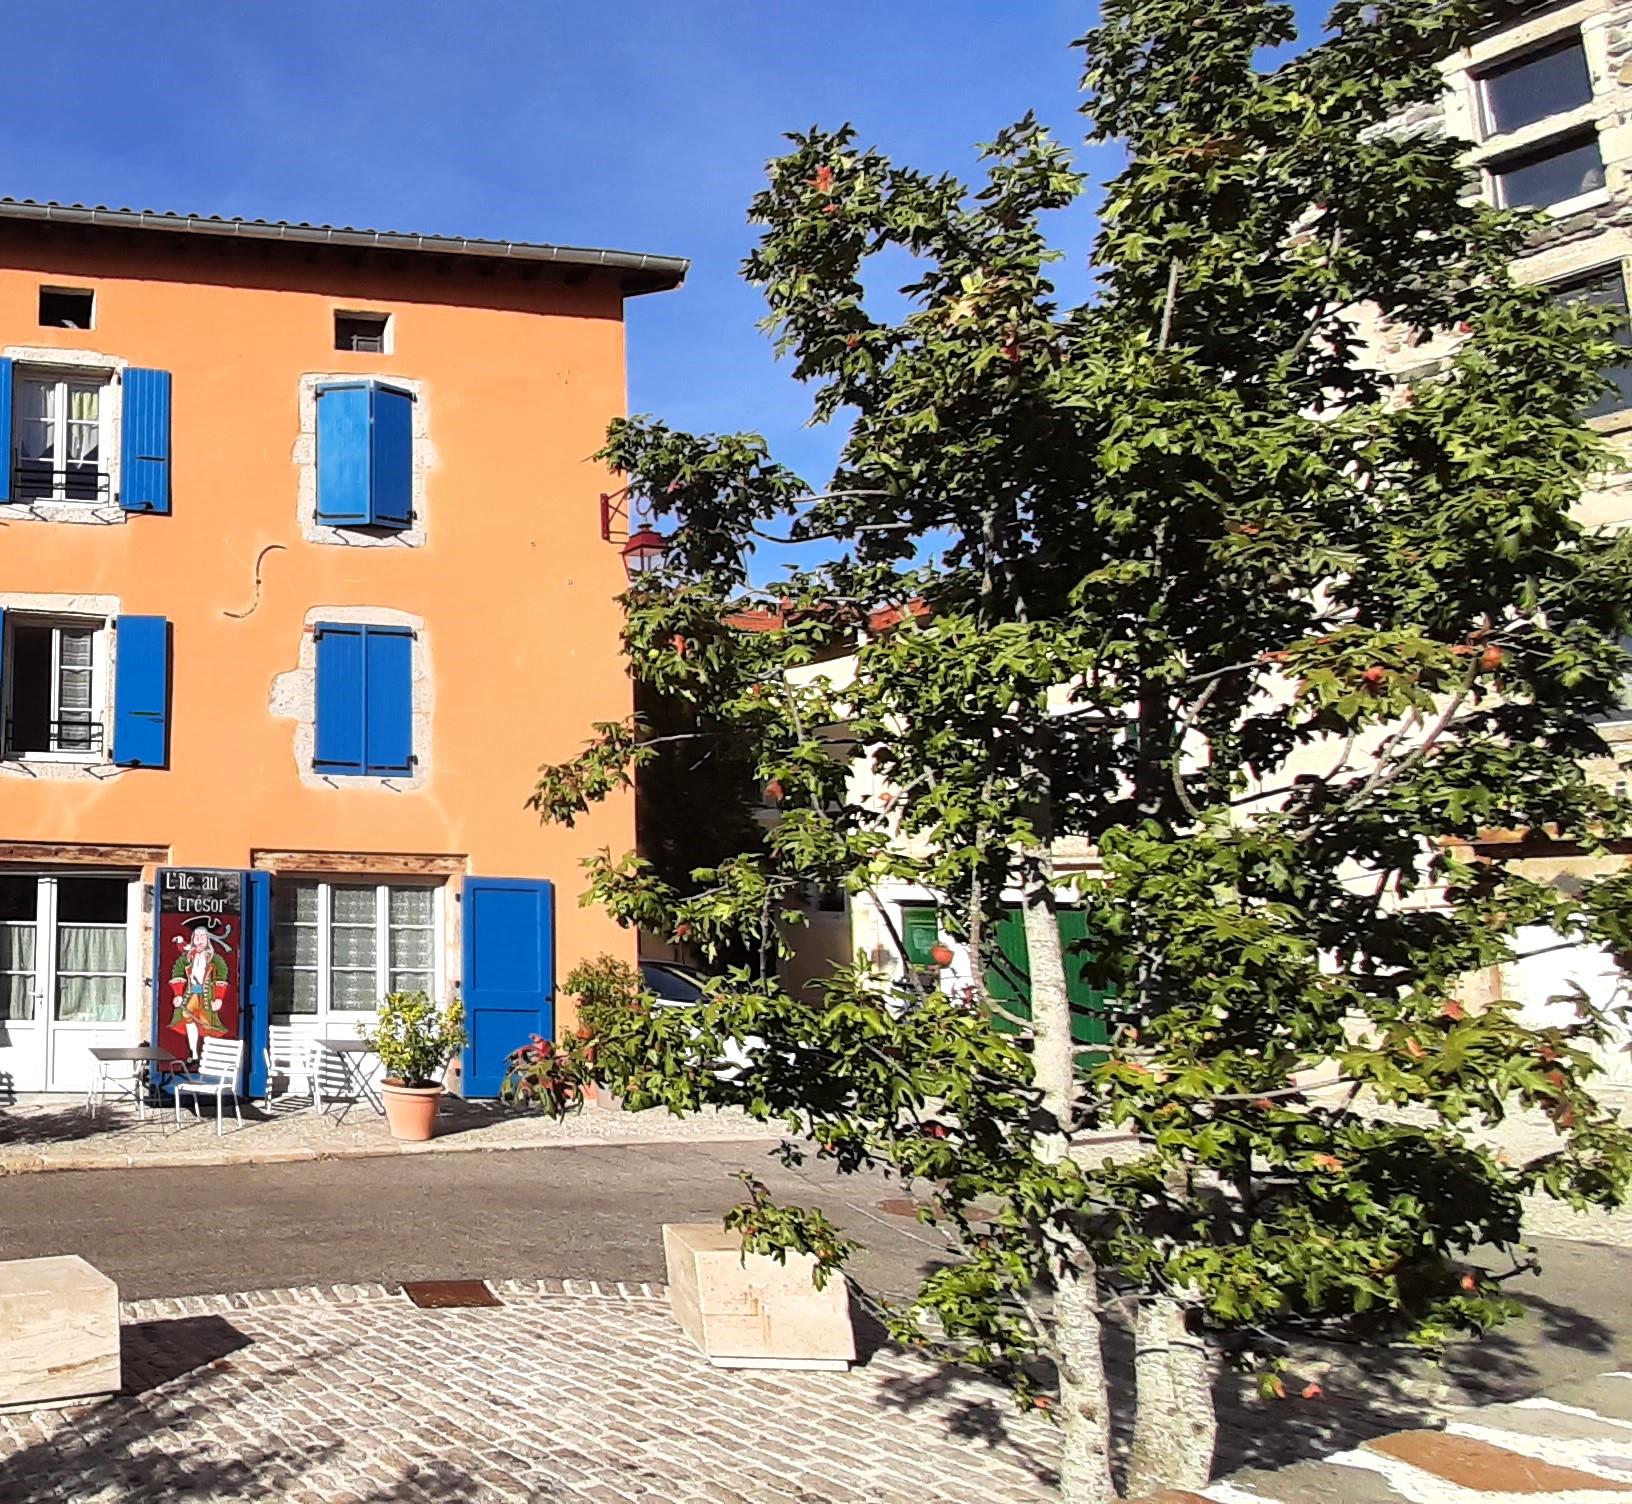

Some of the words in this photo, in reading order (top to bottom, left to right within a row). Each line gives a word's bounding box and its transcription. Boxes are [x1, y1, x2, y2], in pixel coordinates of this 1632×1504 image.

[166, 872, 195, 890] L'île
[202, 876, 219, 891] au
[178, 895, 228, 913] trésor
